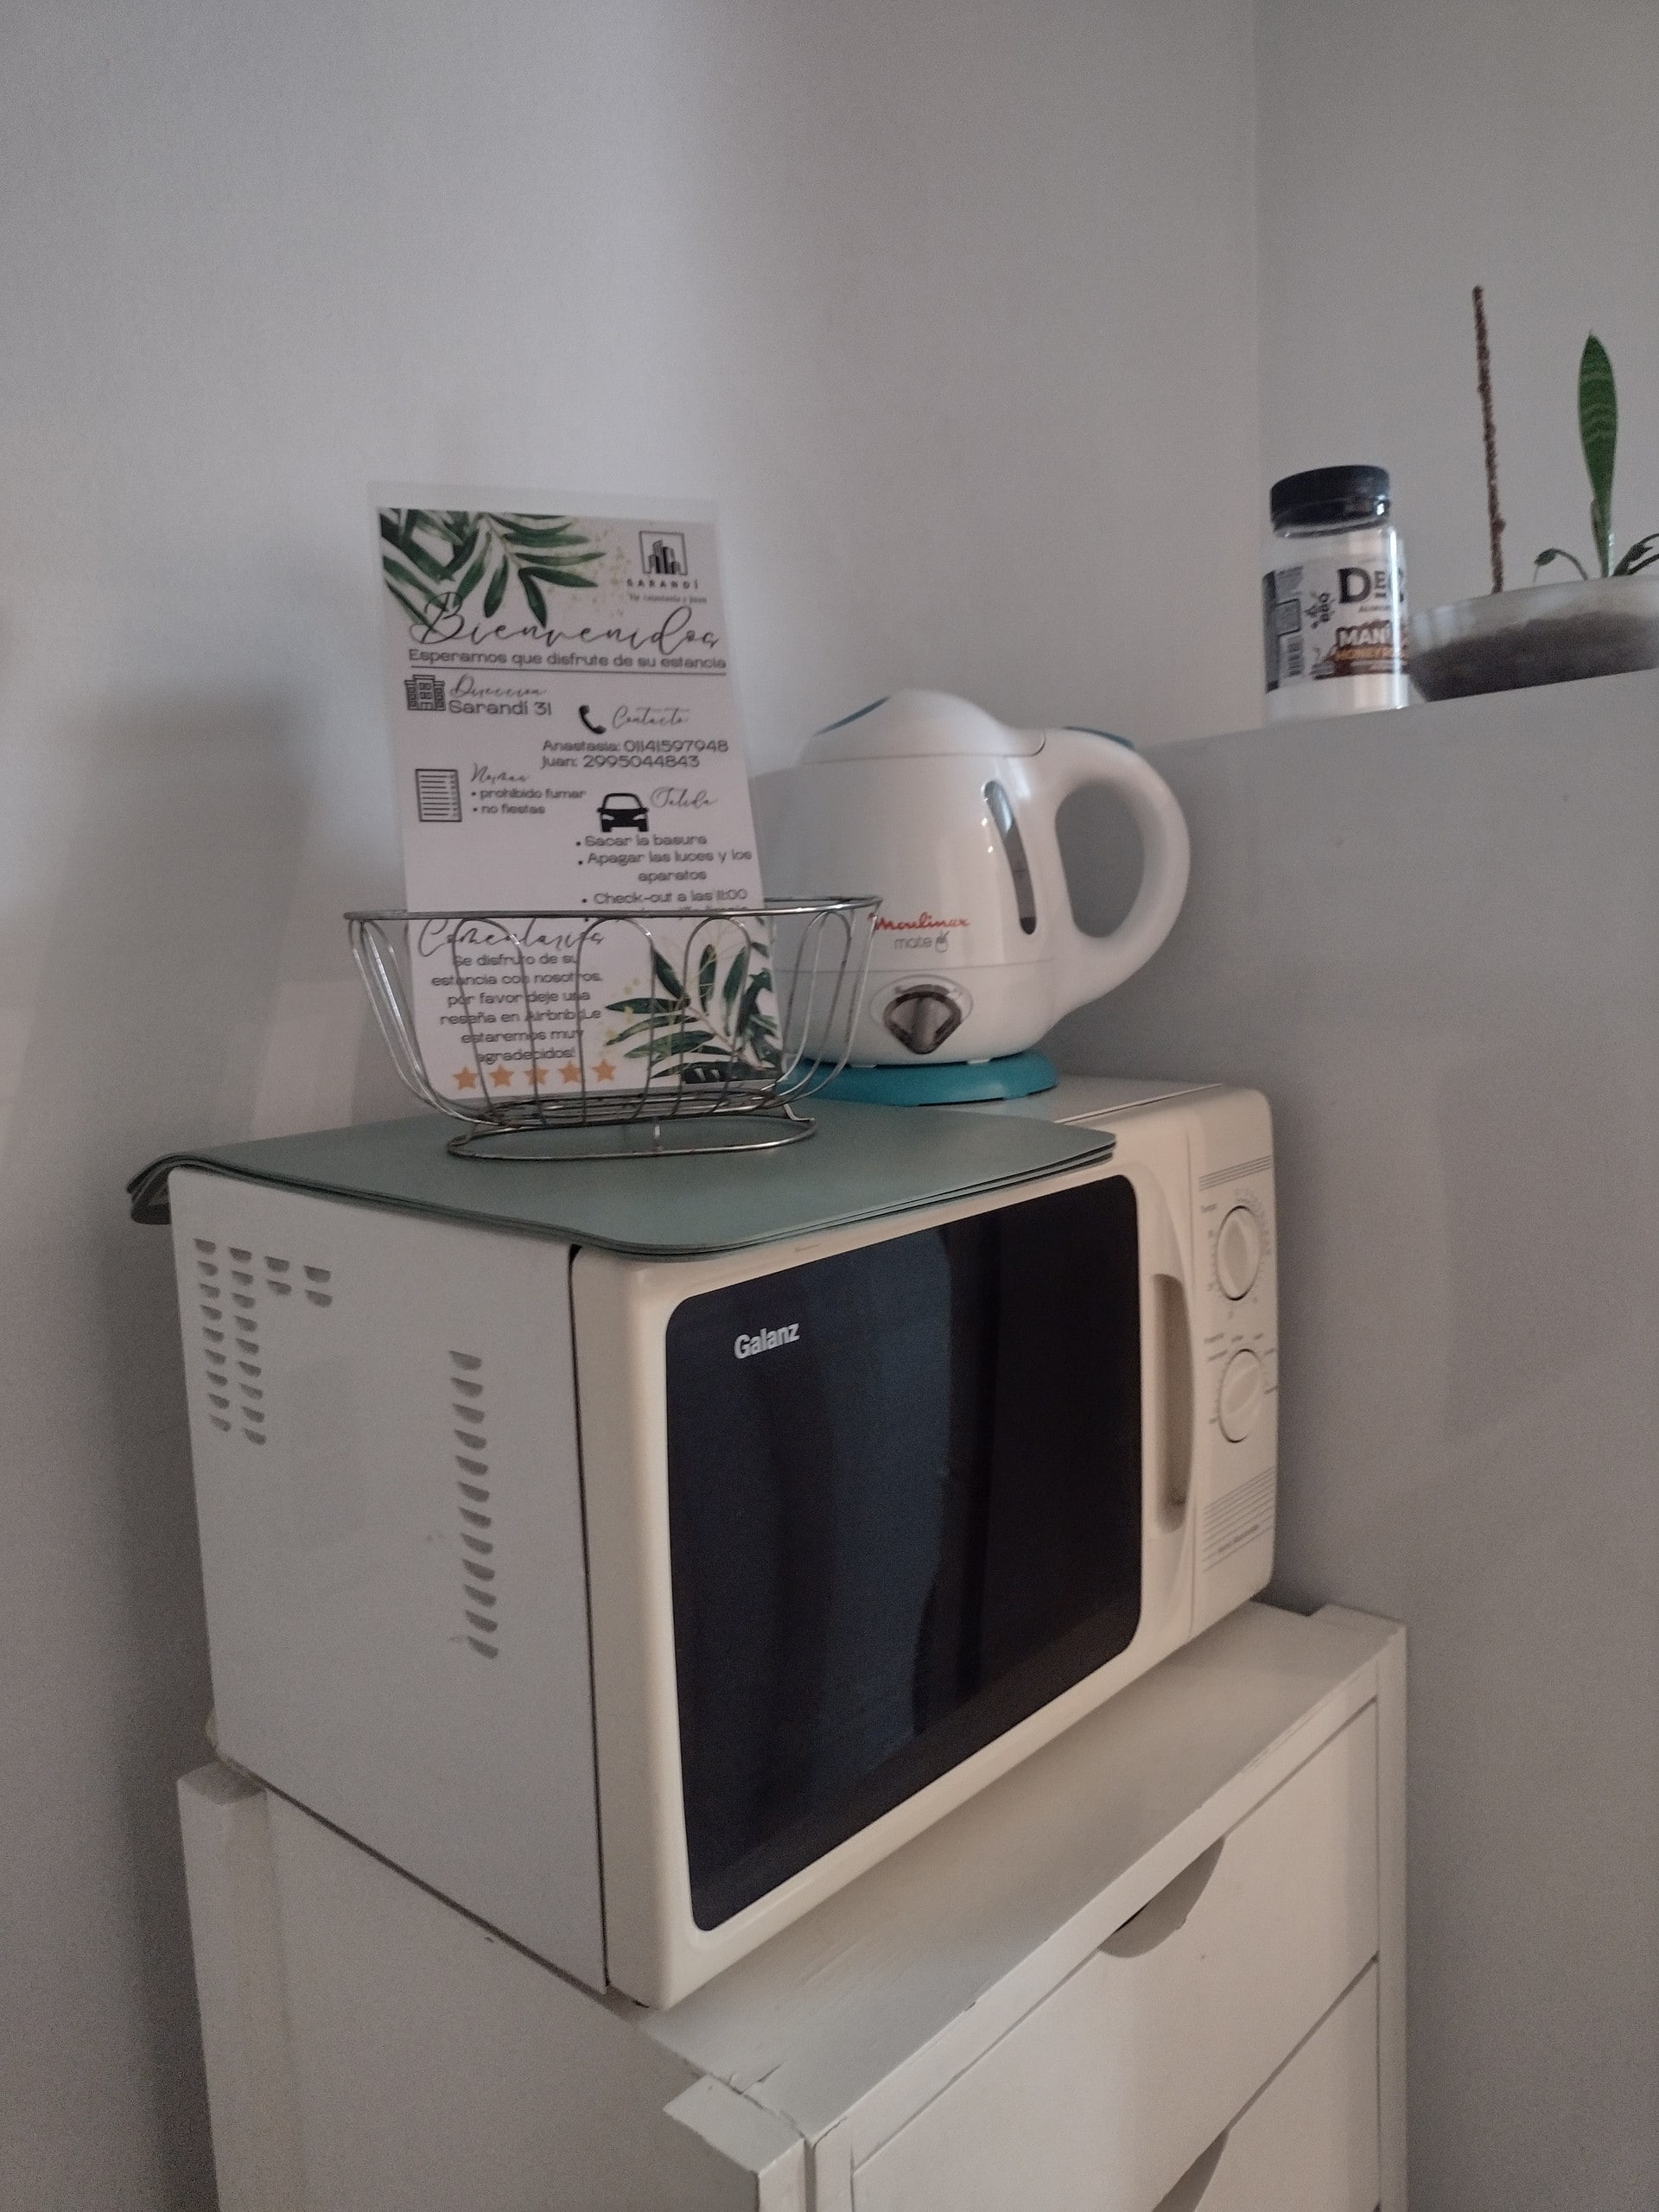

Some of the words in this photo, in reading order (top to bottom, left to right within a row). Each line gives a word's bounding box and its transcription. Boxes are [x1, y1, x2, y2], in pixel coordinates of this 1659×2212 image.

[410, 591, 720, 656] Bienvenidos
[409, 649, 507, 664] Esperamos
[512, 652, 543, 666] que
[547, 652, 609, 666] disfrute
[613, 654, 633, 667] de
[638, 656, 657, 668] su
[660, 656, 727, 669] estancia
[448, 700, 529, 715] Sarandí
[534, 702, 552, 715] 31
[612, 704, 691, 730] Contacto
[623, 740, 729, 753] 01141597948
[582, 754, 701, 769] 2995044843
[480, 787, 543, 801] prohibido
[545, 787, 587, 799] fumar
[482, 804, 499, 815] no
[501, 804, 546, 815] fiestas
[584, 835, 631, 848] Sacar
[636, 834, 649, 847] la
[653, 834, 708, 847] basura
[588, 852, 645, 867] Apagar
[649, 851, 671, 863] las
[675, 849, 714, 861] luces
[718, 850, 728, 863] y
[732, 848, 753, 861] los
[638, 869, 708, 884] aparatos
[594, 890, 673, 905] Check-out
[677, 893, 688, 903] a
[691, 889, 714, 901] las
[894, 936, 934, 950] mate
[539, 953, 558, 965] de
[563, 954, 578, 965] su
[431, 973, 499, 987] estancia
[502, 974, 531, 985] con
[448, 994, 474, 1007] por
[480, 992, 525, 1005] favor
[527, 990, 559, 1005] deje
[563, 990, 591, 1001] una
[440, 1011, 498, 1026] reseña
[501, 1013, 520, 1023] en
[461, 1029, 547, 1044] estaremos
[551, 1029, 585, 1041] muy
[734, 1322, 800, 1359] Galanz
